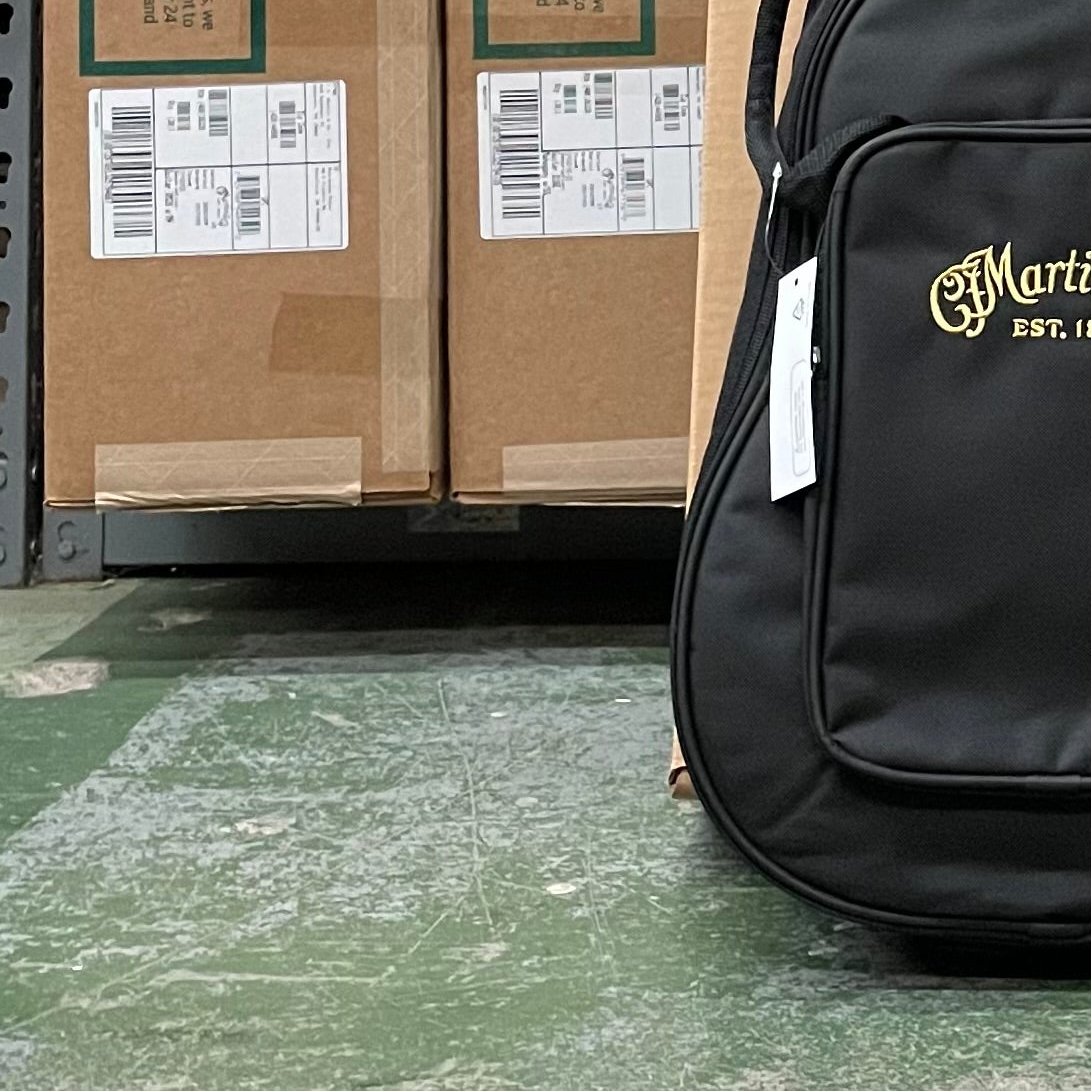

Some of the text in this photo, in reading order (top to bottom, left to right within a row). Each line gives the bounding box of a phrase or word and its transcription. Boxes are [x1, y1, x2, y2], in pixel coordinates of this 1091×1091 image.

[164, 5, 177, 22] 24
[183, 13, 196, 27] to
[203, 10, 214, 30] we
[1012, 318, 1067, 339] EST.
